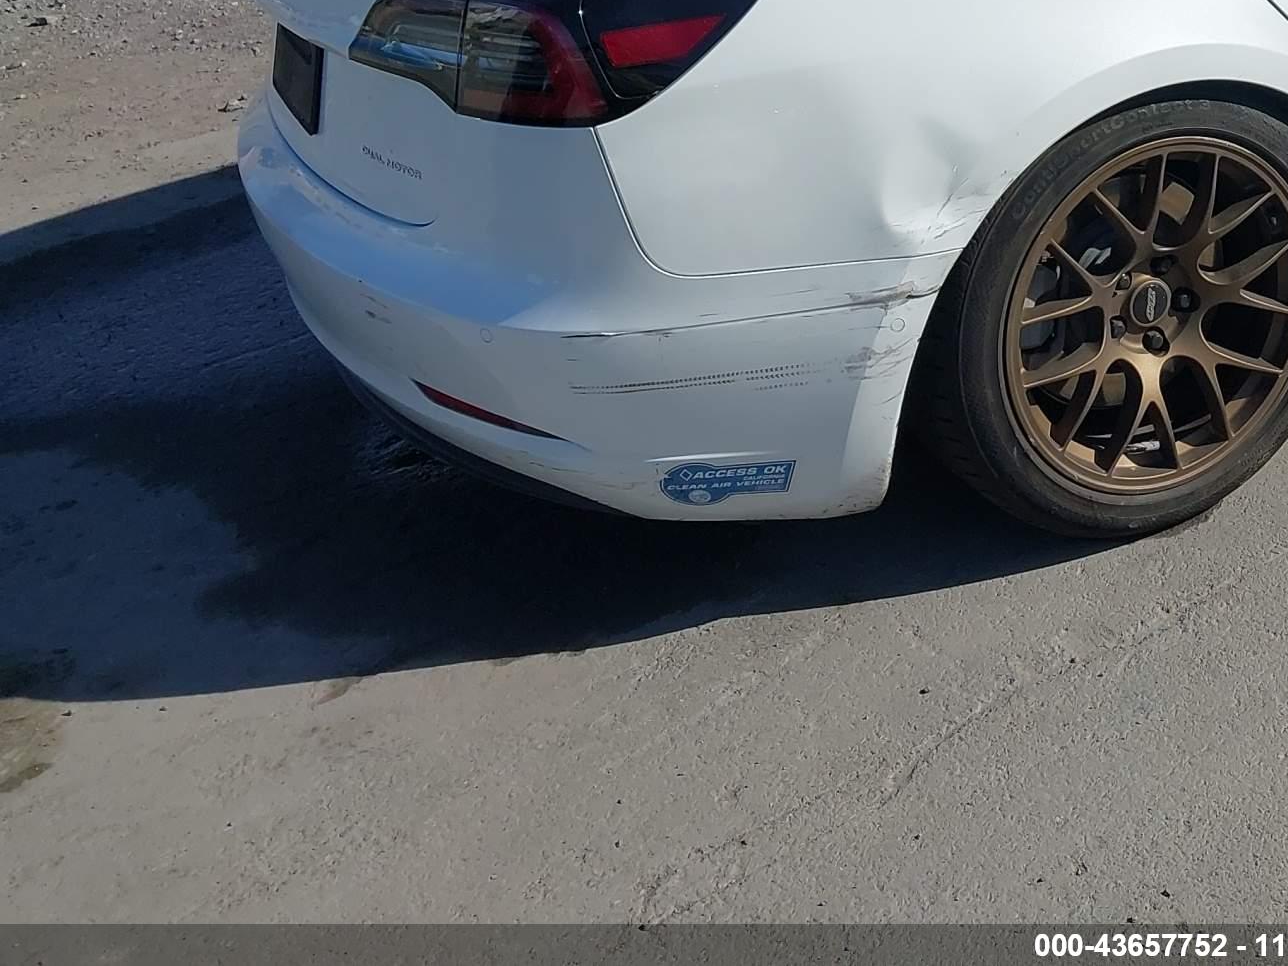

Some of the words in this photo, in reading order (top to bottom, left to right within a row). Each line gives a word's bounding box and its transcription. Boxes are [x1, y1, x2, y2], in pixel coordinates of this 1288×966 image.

[386, 158, 423, 180] MOTOR
[692, 467, 757, 479] ACCESS
[764, 465, 787, 474] OK
[736, 478, 785, 487] VEHICLE
